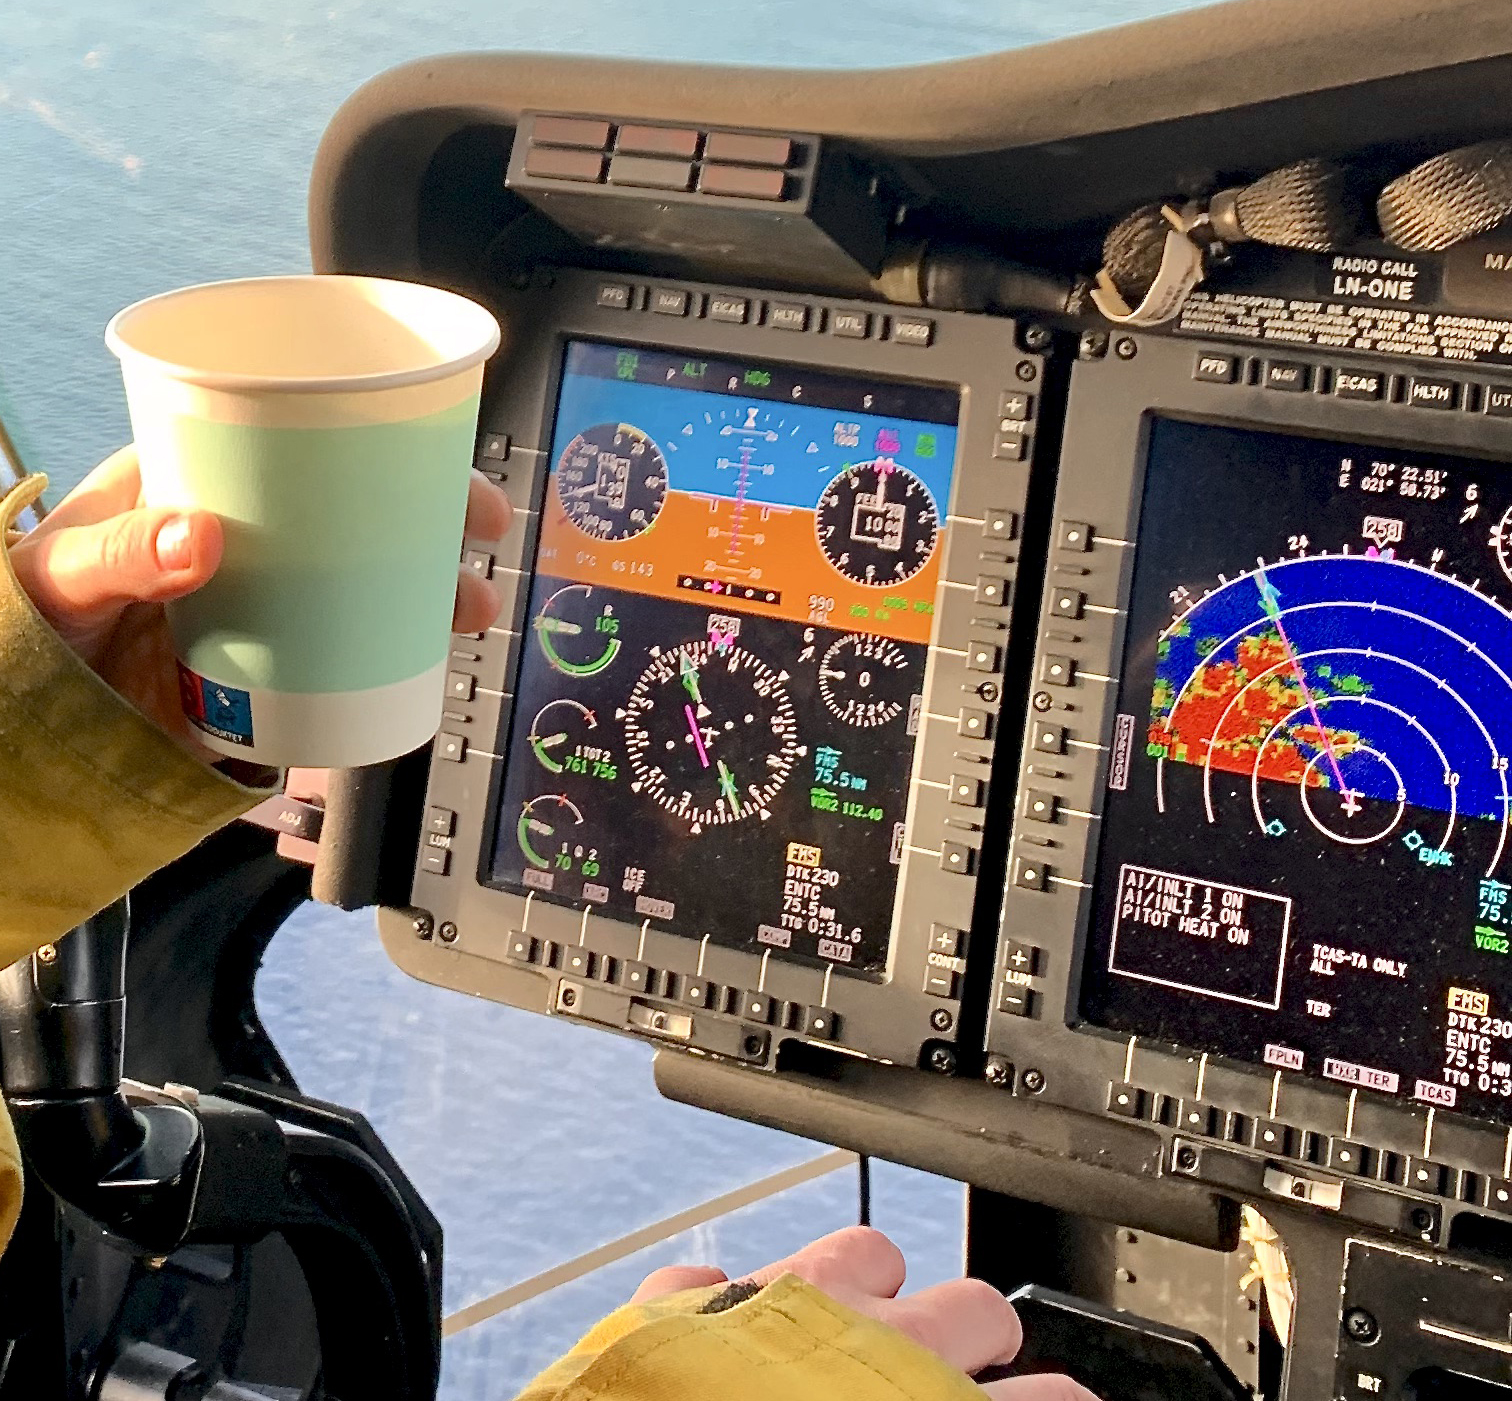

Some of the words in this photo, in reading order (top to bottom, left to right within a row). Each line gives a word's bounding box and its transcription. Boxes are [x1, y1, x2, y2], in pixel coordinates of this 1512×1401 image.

[1332, 256, 1378, 274] RADIO
[1380, 261, 1419, 278] CALL
[1332, 276, 1415, 301] LN-ONE
[1347, 305, 1411, 323] OPERATED
[1434, 326, 1500, 342] APPROVED
[1338, 473, 1350, 488] E
[1465, 483, 1478, 501] 6
[629, 561, 654, 577] 143
[808, 595, 835, 612] 990
[594, 616, 620, 634] 105
[802, 627, 816, 643] 6
[858, 671, 871, 688] 0
[602, 750, 612, 763] 2
[1491, 754, 1509, 771] 15
[564, 756, 587, 774] 761
[593, 761, 618, 781] 756
[1442, 772, 1460, 787] 10
[1396, 787, 1407, 802] 5
[278, 810, 303, 827] ADJ
[429, 834, 451, 849] LUM
[588, 848, 598, 861] 2
[784, 879, 822, 901] ENTC
[1125, 871, 1196, 899] AI/INLT
[1203, 887, 1212, 903] 1
[1221, 891, 1244, 910] ON
[1478, 886, 1508, 905] FMS
[1123, 888, 1194, 915] AI/INLT
[1200, 903, 1213, 921] 2
[1219, 907, 1242, 926] ON
[807, 919, 863, 943] 0:31.6
[1121, 904, 1172, 929] PITOT
[1178, 915, 1220, 939] HEAT
[1227, 926, 1250, 946] ON
[927, 952, 958, 969] CONT
[1309, 957, 1336, 976] ALL
[1312, 943, 1368, 969] TCAS-TA
[1373, 957, 1408, 979] ONLY
[1306, 999, 1332, 1017] TER
[1454, 992, 1485, 1012] FMS
[1447, 1011, 1477, 1031] DTK
[1446, 1028, 1492, 1054] ENTC
[1268, 1048, 1300, 1066] FPLN
[1367, 1071, 1390, 1087] TER
[1442, 1068, 1470, 1087] TTG
[1420, 1082, 1452, 1102] TCAS
[1357, 1373, 1383, 1393] BRT
